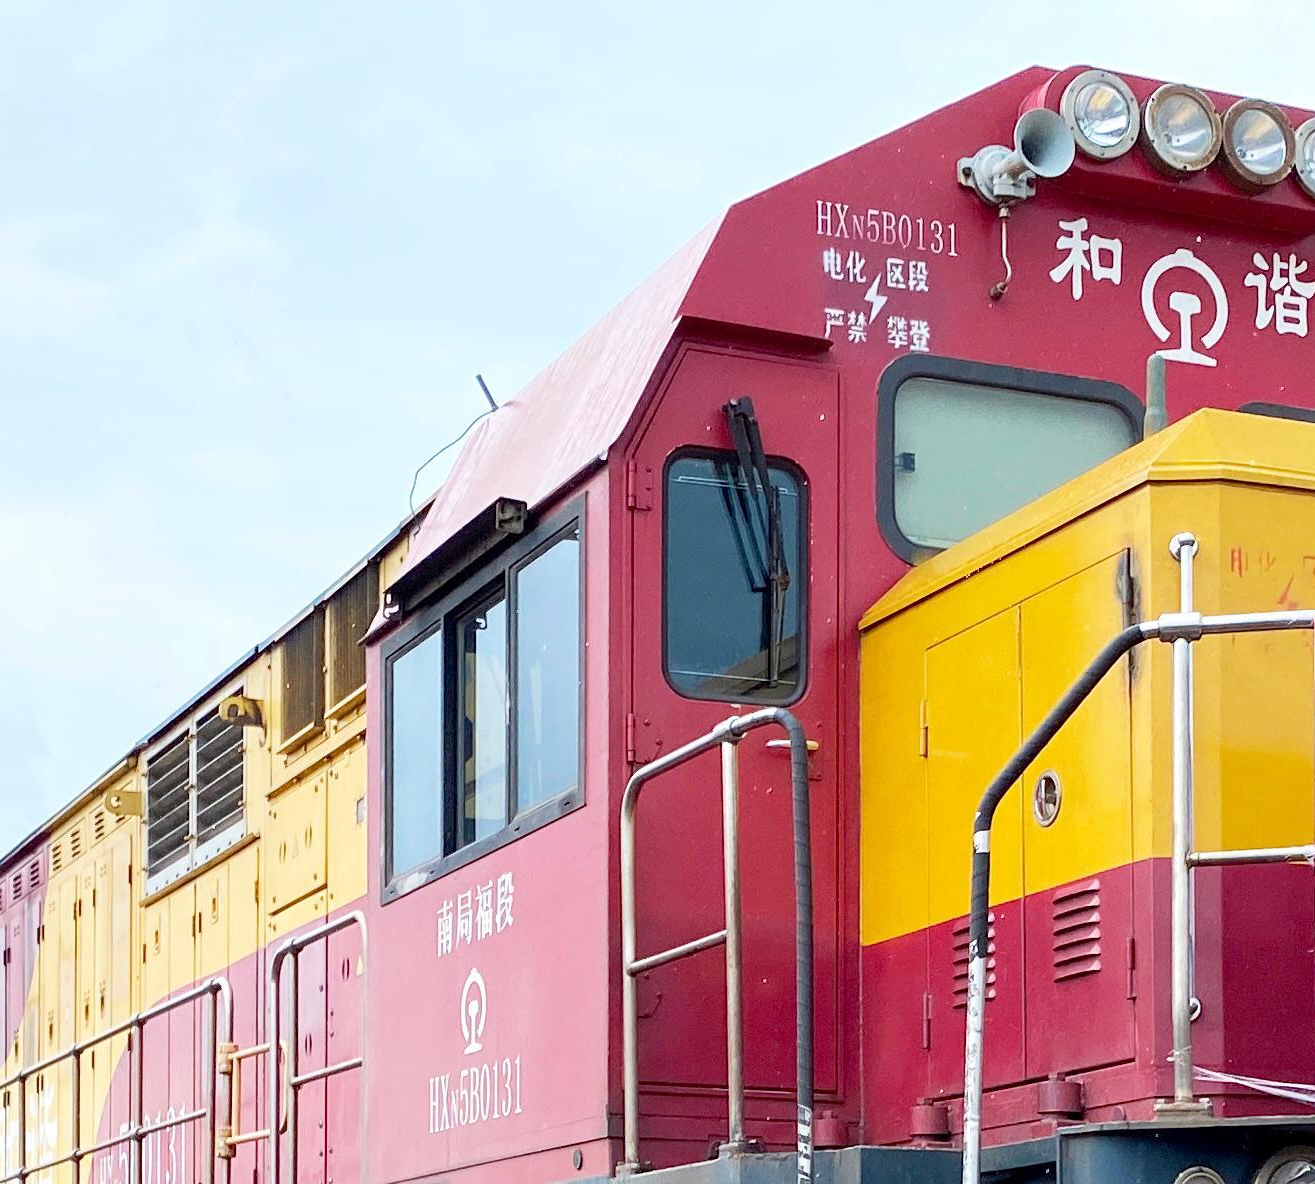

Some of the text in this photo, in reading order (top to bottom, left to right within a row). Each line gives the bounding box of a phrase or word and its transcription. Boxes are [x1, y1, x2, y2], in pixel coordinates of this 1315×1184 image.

[1048, 217, 1123, 301] 和
[437, 871, 515, 958] 南局福段
